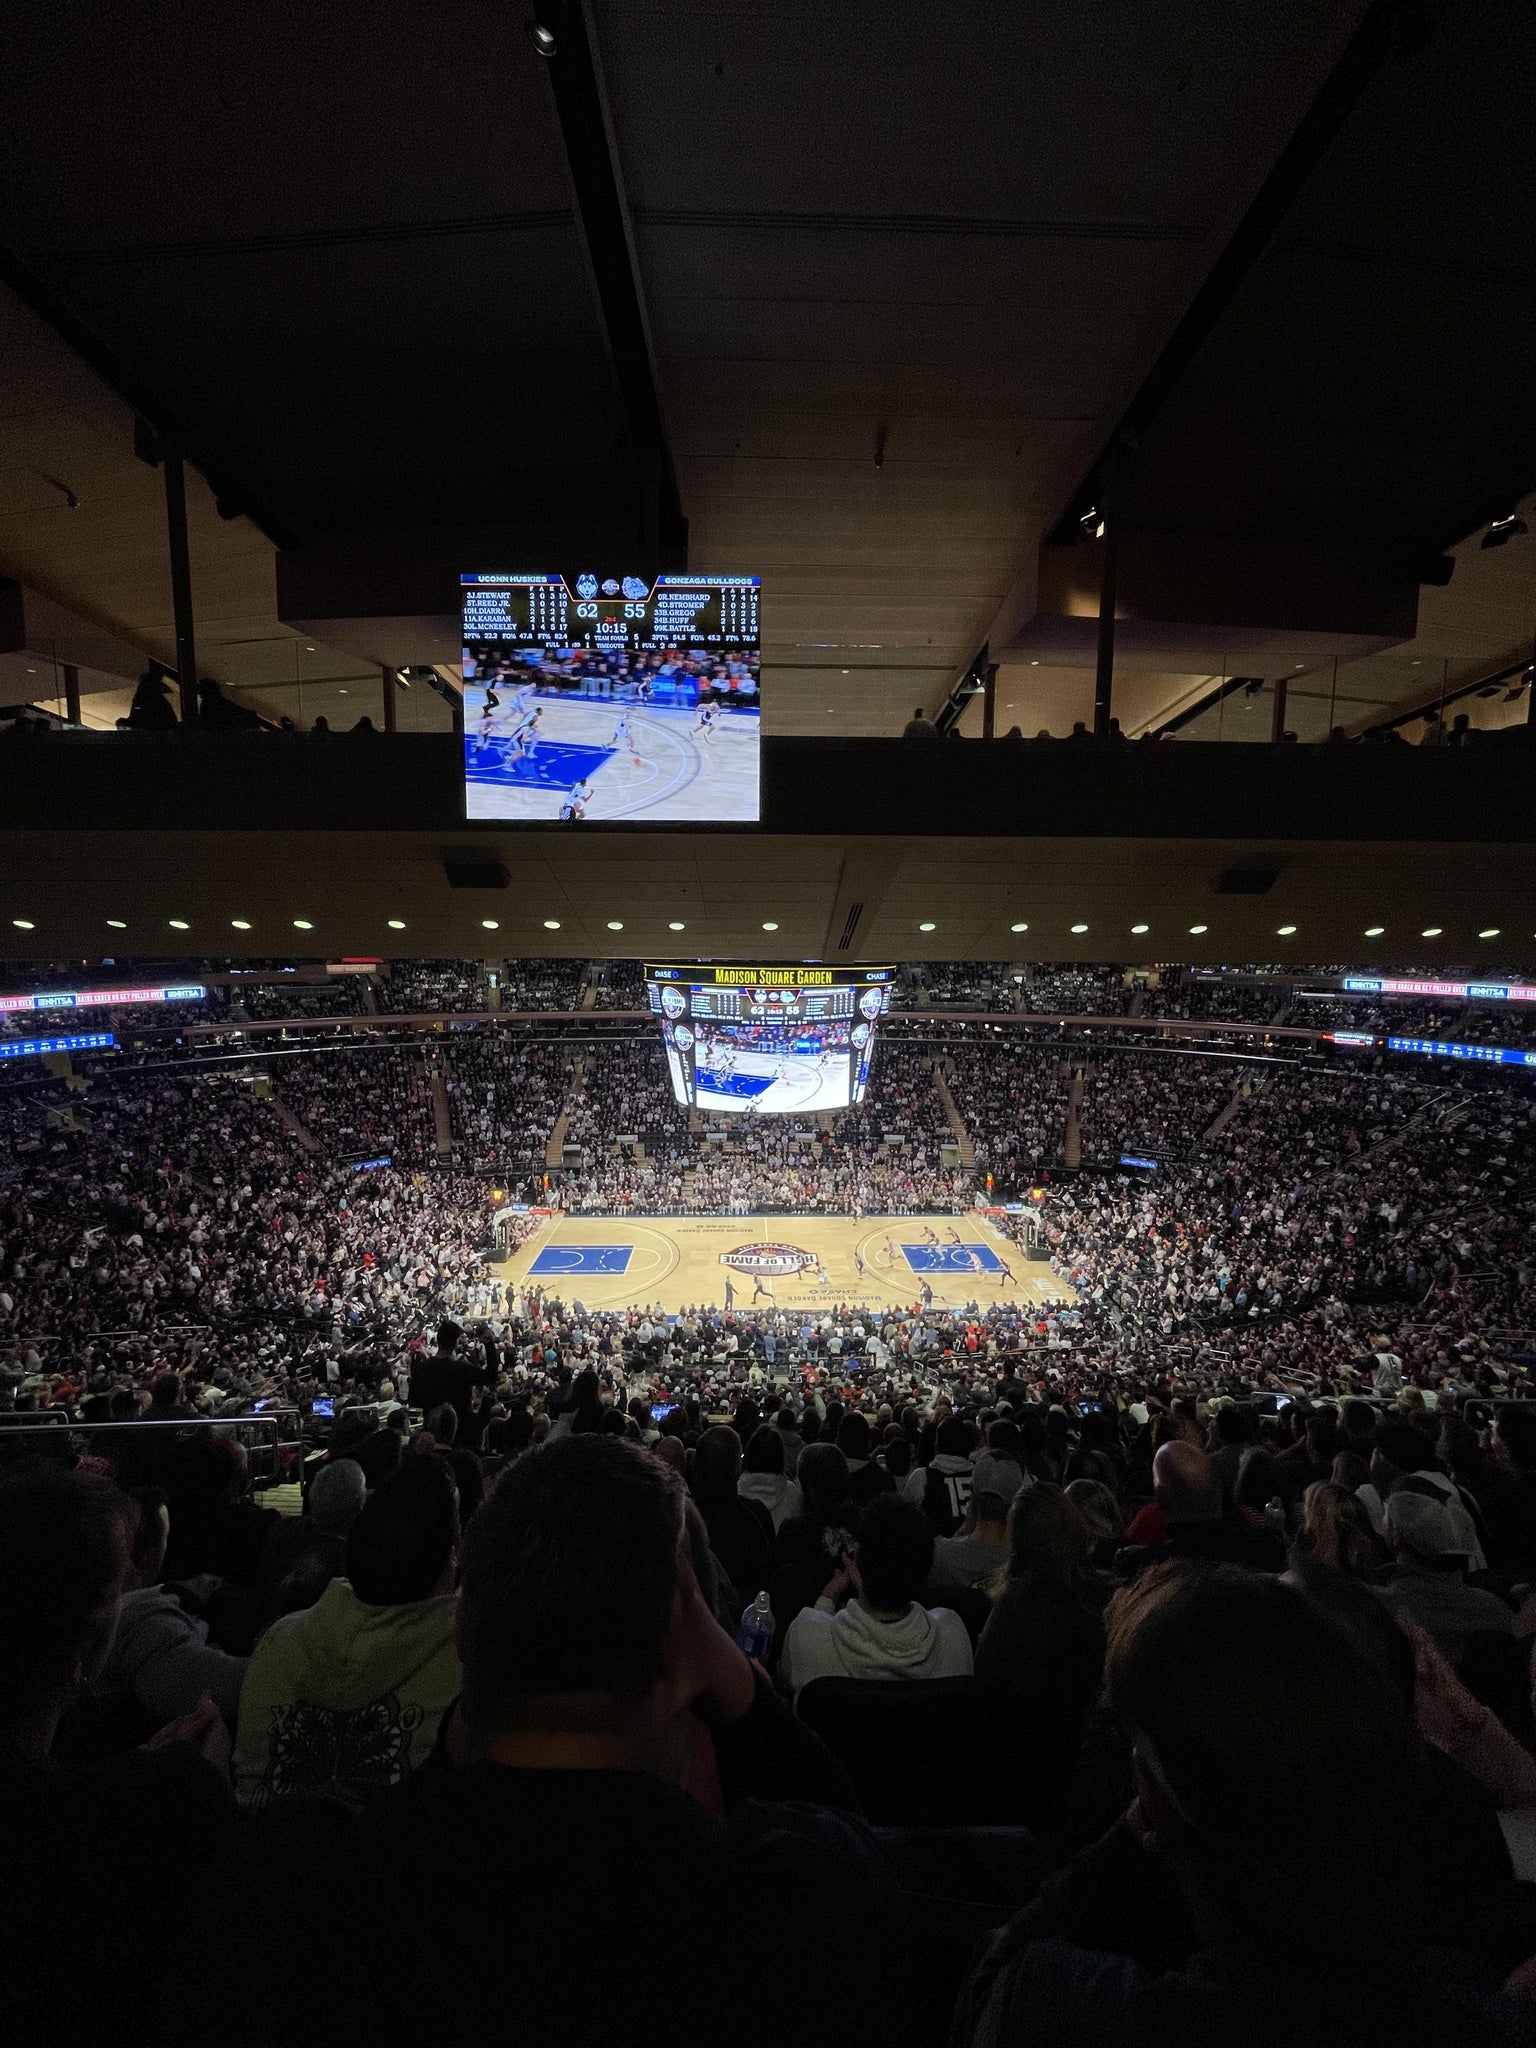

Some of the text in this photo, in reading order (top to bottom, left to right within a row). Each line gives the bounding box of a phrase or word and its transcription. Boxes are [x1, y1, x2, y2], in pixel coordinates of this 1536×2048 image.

[576, 603, 598, 618] 62
[624, 604, 645, 618] 55
[596, 623, 627, 634] 10:15
[715, 969, 832, 984] MADISON SQUARE GARDEN
[1478, 988, 1504, 996] NHTSA
[45, 997, 73, 1005] NHTSA
[750, 1006, 764, 1015] 62
[786, 1006, 800, 1015] 55
[723, 1256, 760, 1264] FAME
